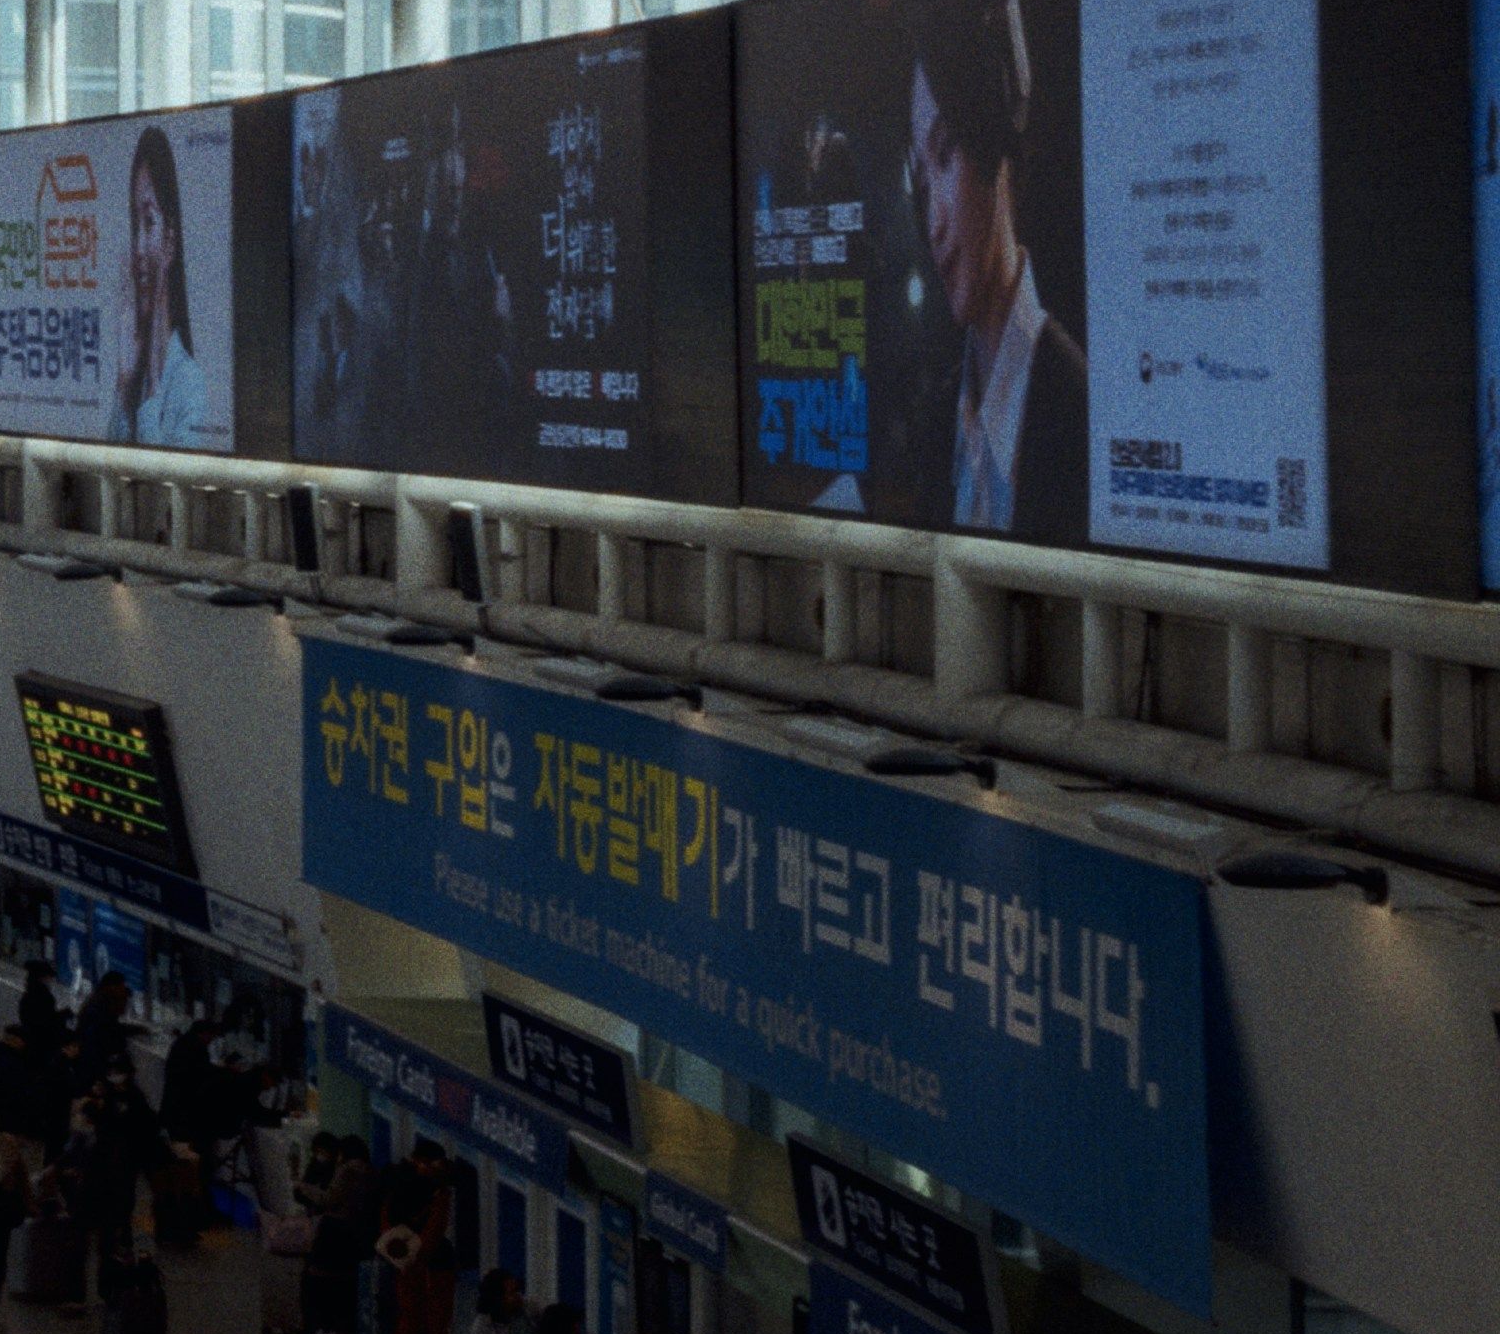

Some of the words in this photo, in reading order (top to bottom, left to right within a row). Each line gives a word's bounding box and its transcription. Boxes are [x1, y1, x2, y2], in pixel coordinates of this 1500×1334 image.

[45, 214, 99, 290] 든든한
[540, 194, 567, 274] 더
[320, 676, 409, 805] 승차권
[427, 704, 516, 839] 구입은
[534, 732, 760, 932] 자동발매기가
[777, 825, 891, 966] 빠르고
[917, 868, 1159, 1110] 편리합니다.
[433, 852, 489, 914] Please
[492, 885, 524, 929] use
[528, 897, 541, 935] a
[545, 894, 600, 958] ticket
[604, 927, 692, 1000] machine
[696, 952, 729, 1017] for
[735, 985, 750, 1029] a
[756, 992, 822, 1063] quick
[829, 1027, 948, 1121] purchase.
[346, 1024, 394, 1088] Foreign
[396, 1052, 436, 1107] Cards
[470, 1092, 538, 1164] Available
[523, 1027, 557, 1072] 승차권
[557, 1042, 581, 1083] 사는
[581, 1052, 597, 1091] 곳
[843, 1183, 888, 1241] 승차권
[889, 1208, 921, 1259] 사는
[921, 1223, 941, 1271] 곳
